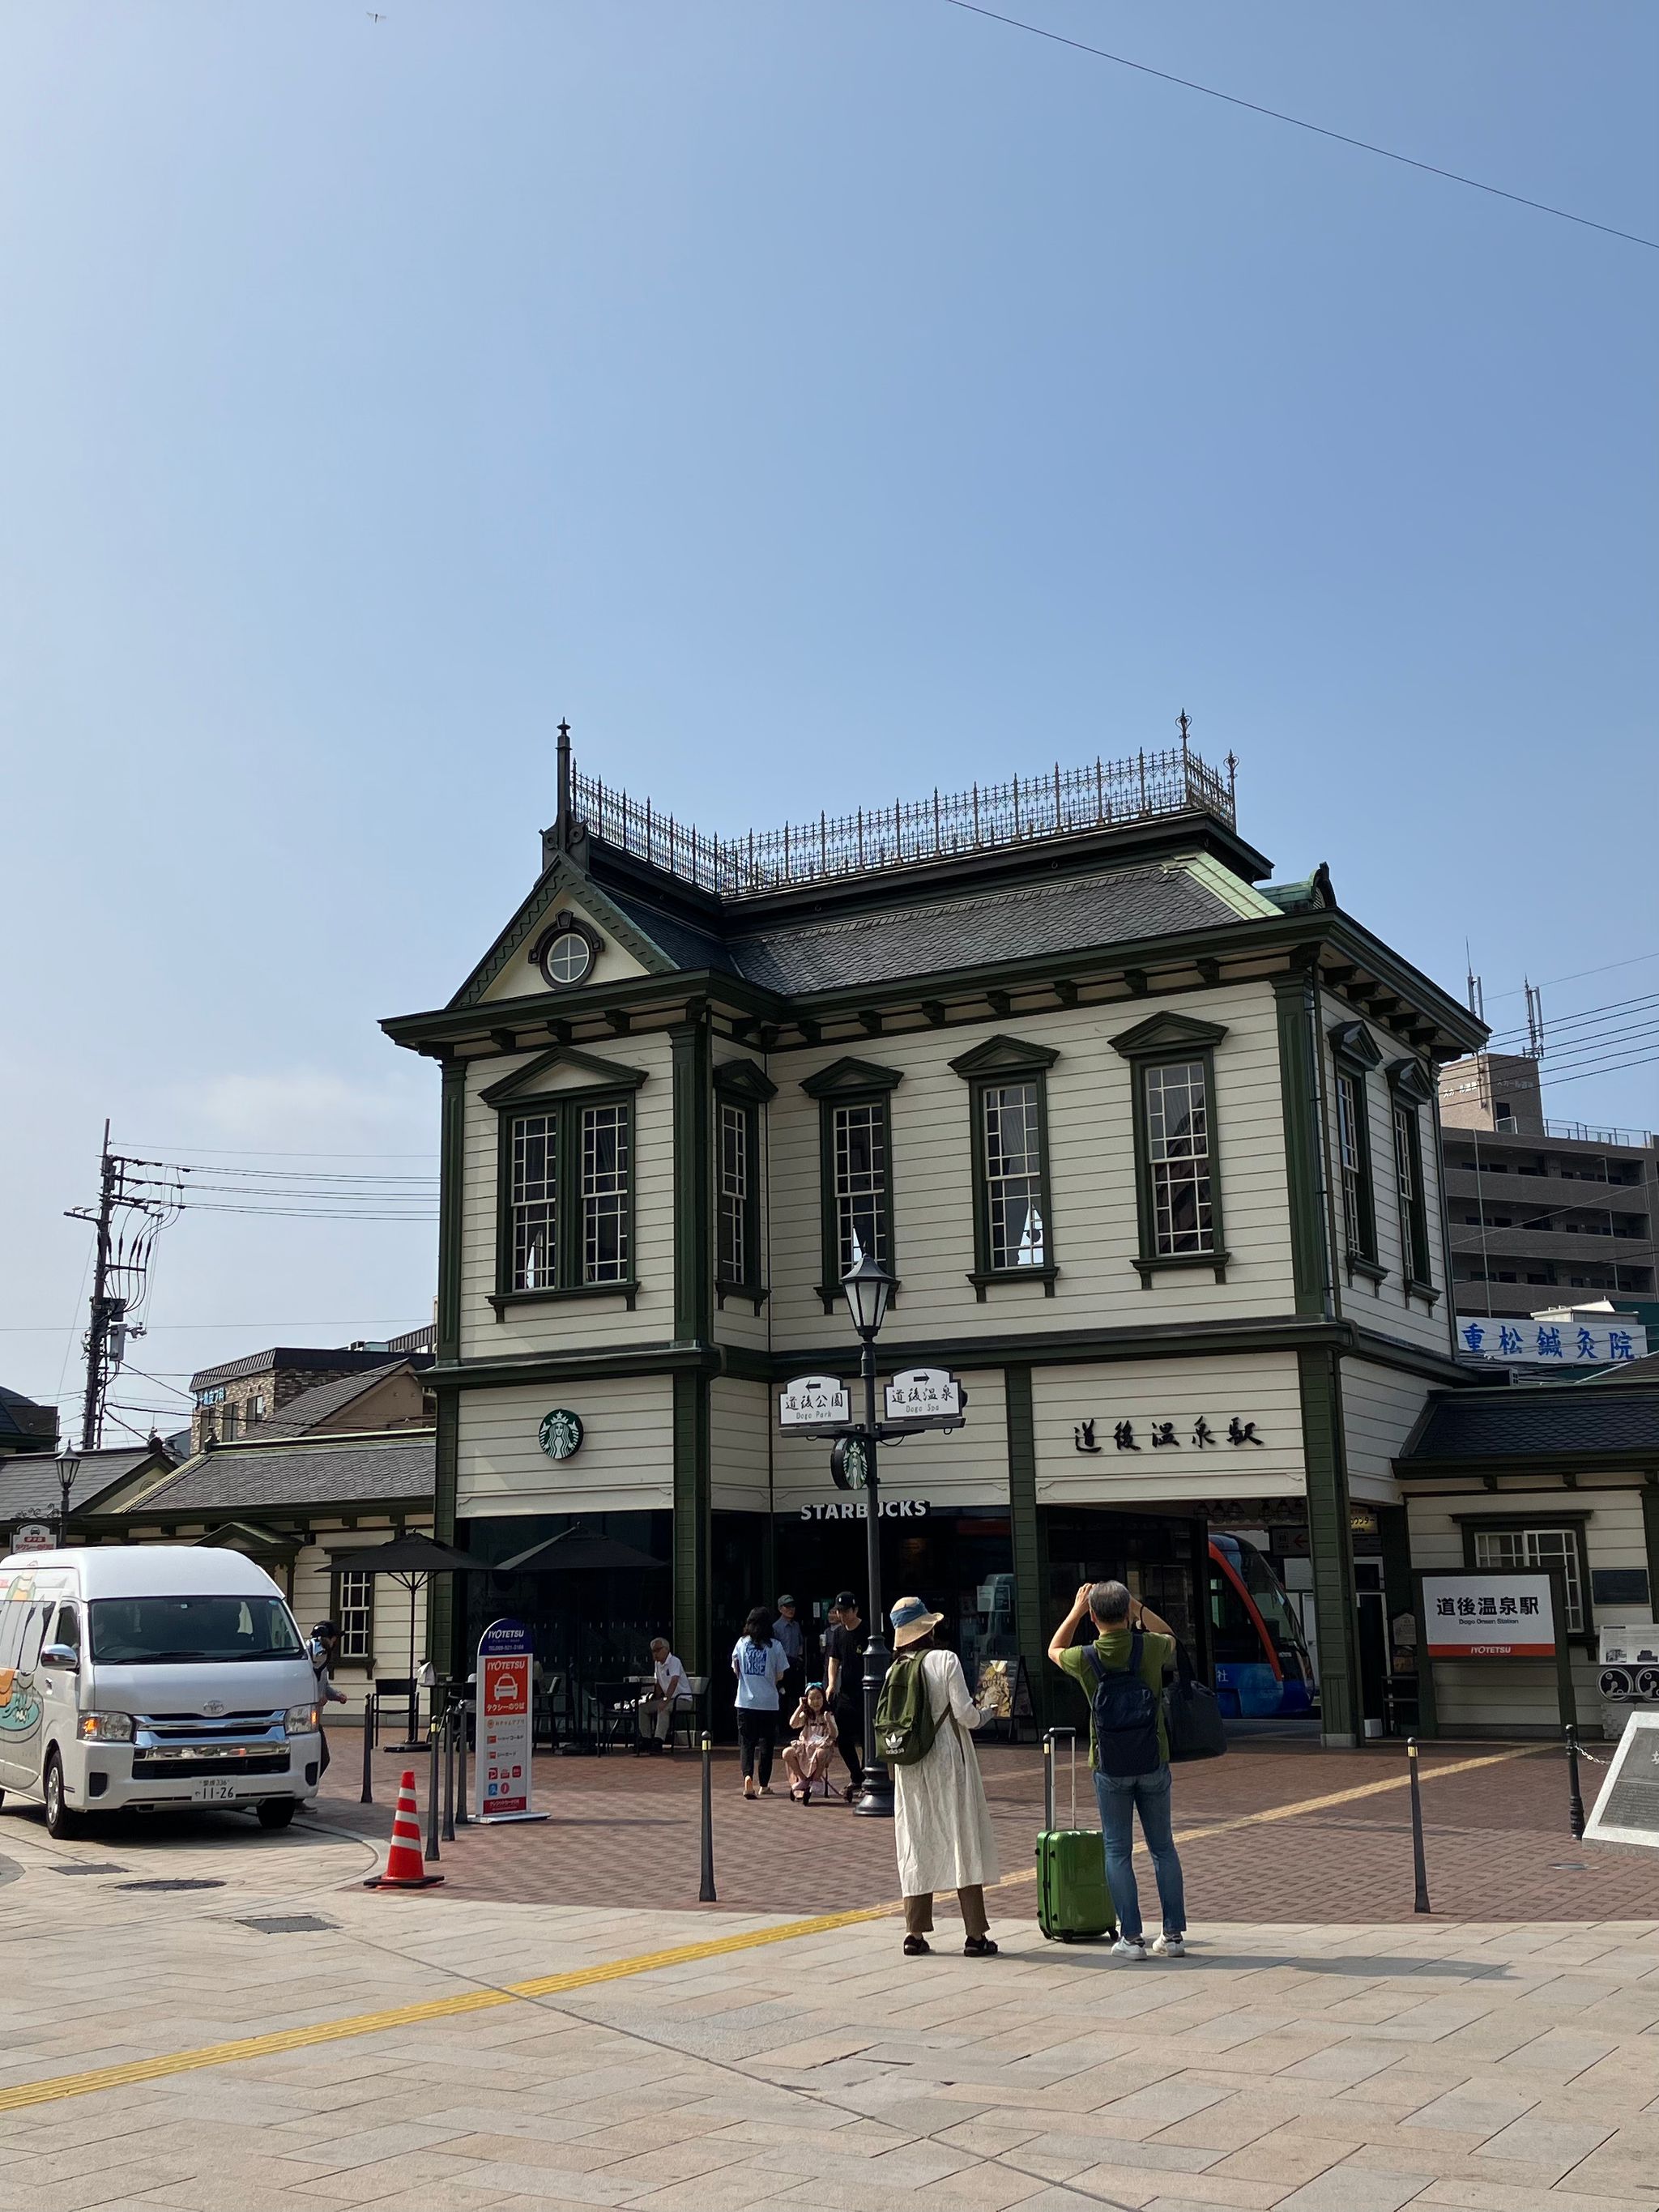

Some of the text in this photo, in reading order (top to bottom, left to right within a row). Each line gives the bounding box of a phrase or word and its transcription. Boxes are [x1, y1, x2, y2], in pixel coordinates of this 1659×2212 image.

[892, 1384, 953, 1404] 道後温泉
[785, 1392, 843, 1410] 道後公園
[906, 1403, 940, 1413] Dogo Spa
[795, 1410, 832, 1420] Dogo Park
[1073, 1416, 1264, 1453] 道後温泉駅
[1436, 1596, 1539, 1616] 道後温泉駅
[488, 1630, 525, 1639] IYOTETSU
[1470, 1646, 1512, 1654] IYOTETSU
[487, 1660, 526, 1671] IYOTETSU
[487, 1702, 525, 1711] タクシーのりば
[203, 1786, 234, 1799] 11-26
